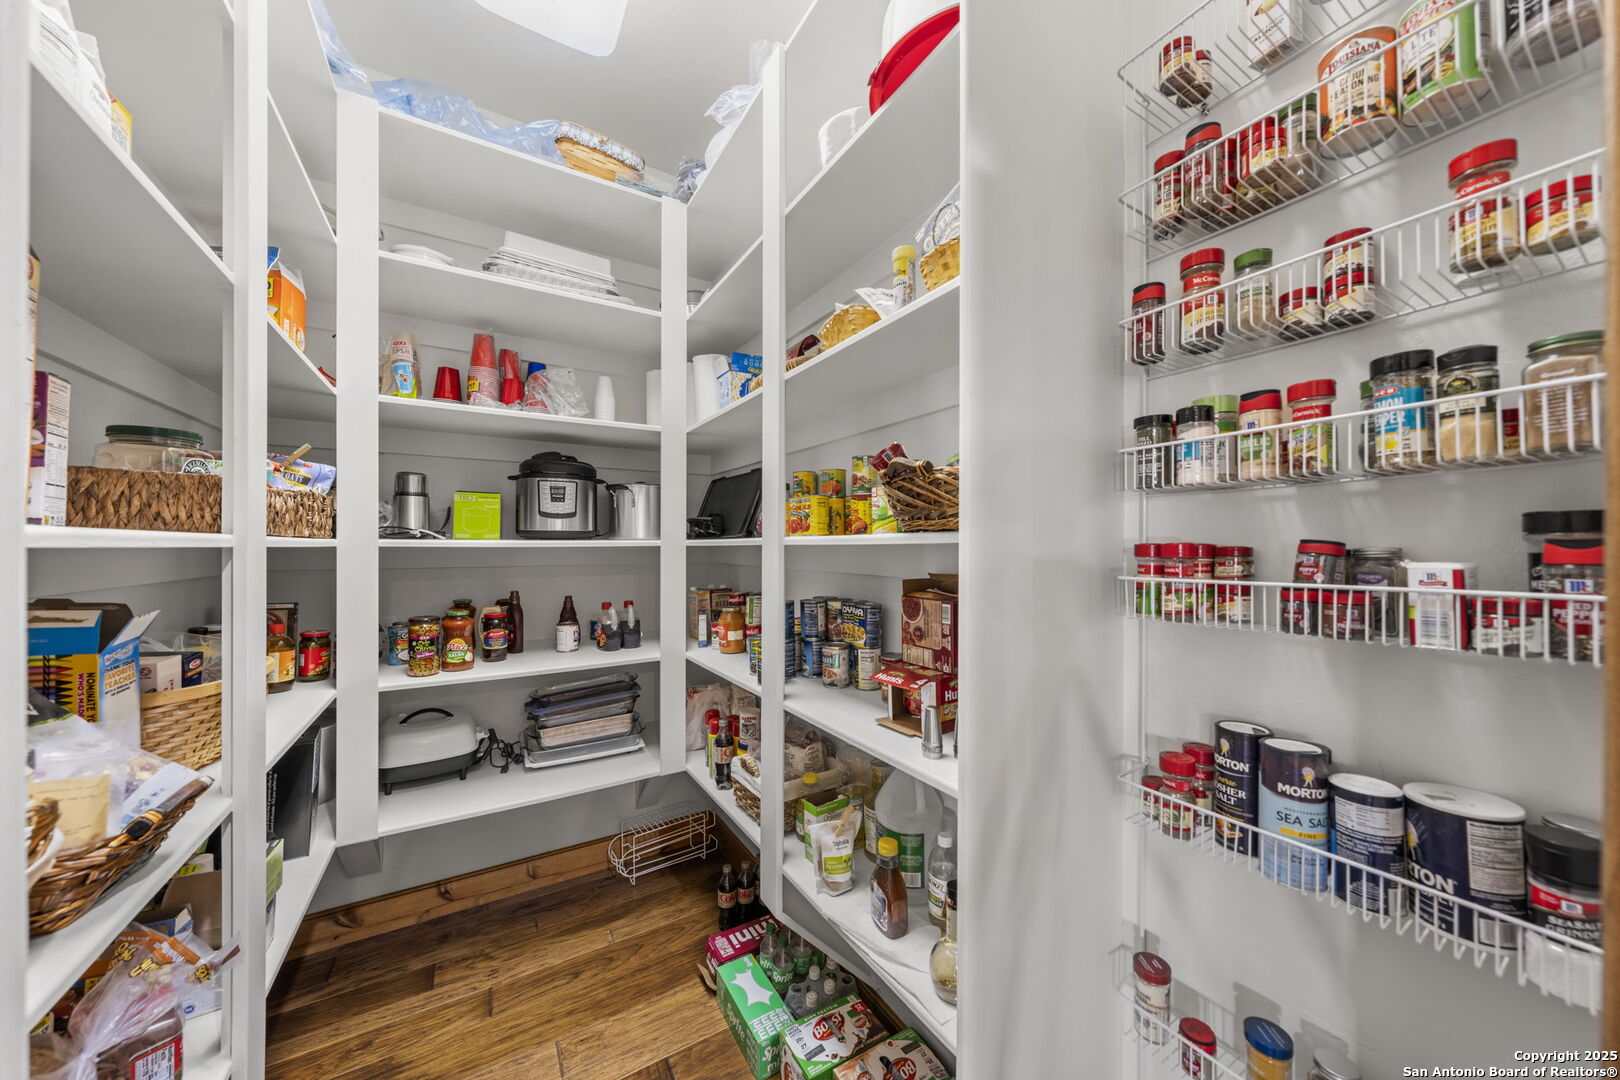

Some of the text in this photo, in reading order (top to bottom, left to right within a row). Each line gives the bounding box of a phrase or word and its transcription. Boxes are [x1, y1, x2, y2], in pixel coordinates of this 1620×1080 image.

[1411, 27, 1436, 50] LTE
[77, 673, 85, 696] WHO'S
[86, 672, 96, 712] NOMINATE
[1276, 810, 1328, 829] SEA SAL
[1408, 860, 1455, 895] TON
[1545, 923, 1602, 941] GRINDE
[815, 1013, 842, 1039] BOST
